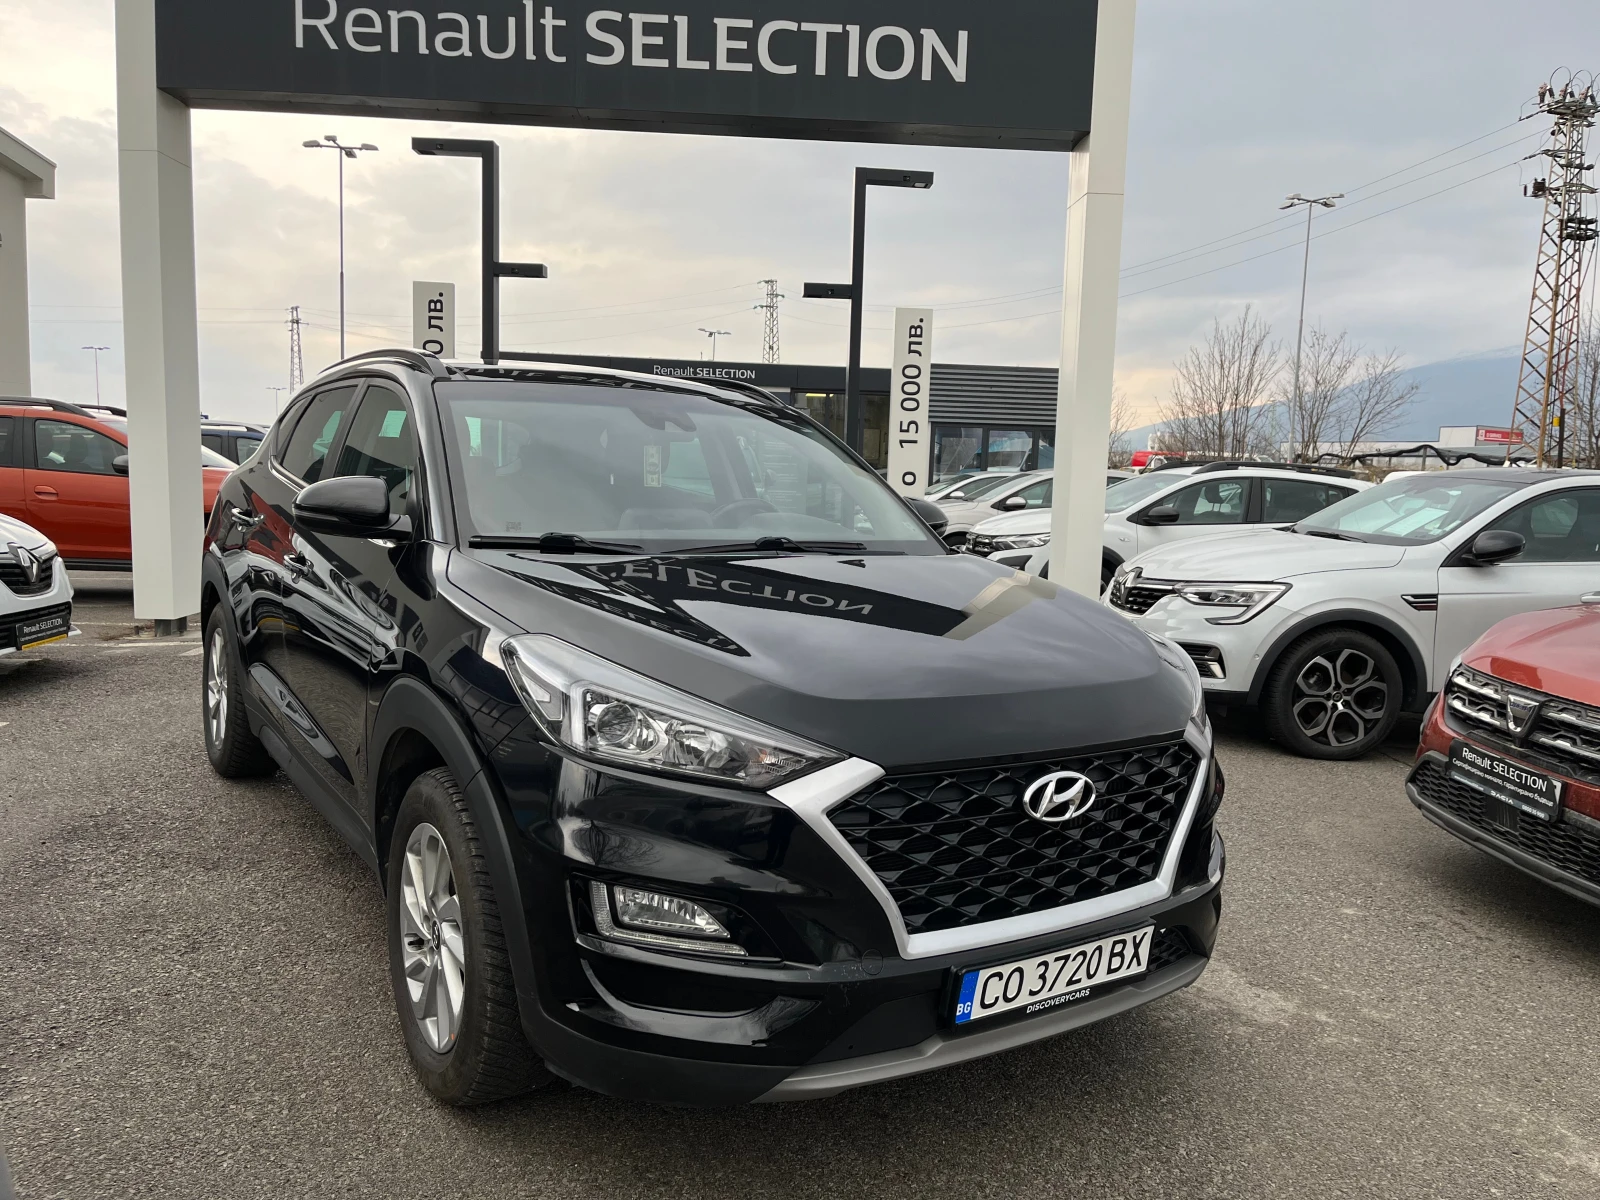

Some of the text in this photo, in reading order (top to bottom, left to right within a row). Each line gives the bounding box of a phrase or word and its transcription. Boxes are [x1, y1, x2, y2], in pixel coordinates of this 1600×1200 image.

[295, 0, 968, 83] Renault SELECTION
[908, 318, 923, 357] лв.
[653, 365, 756, 379] Renault SELECTION
[901, 364, 921, 412] 000
[899, 420, 919, 448] 15
[40, 618, 62, 630] SELECTION
[1462, 747, 1492, 770] Renault
[1492, 761, 1548, 792] SELECTION
[979, 931, 1149, 1010] CO 3720 BX
[956, 1002, 972, 1016] BG
[1027, 989, 1090, 1013] DISCOVERYCARS
